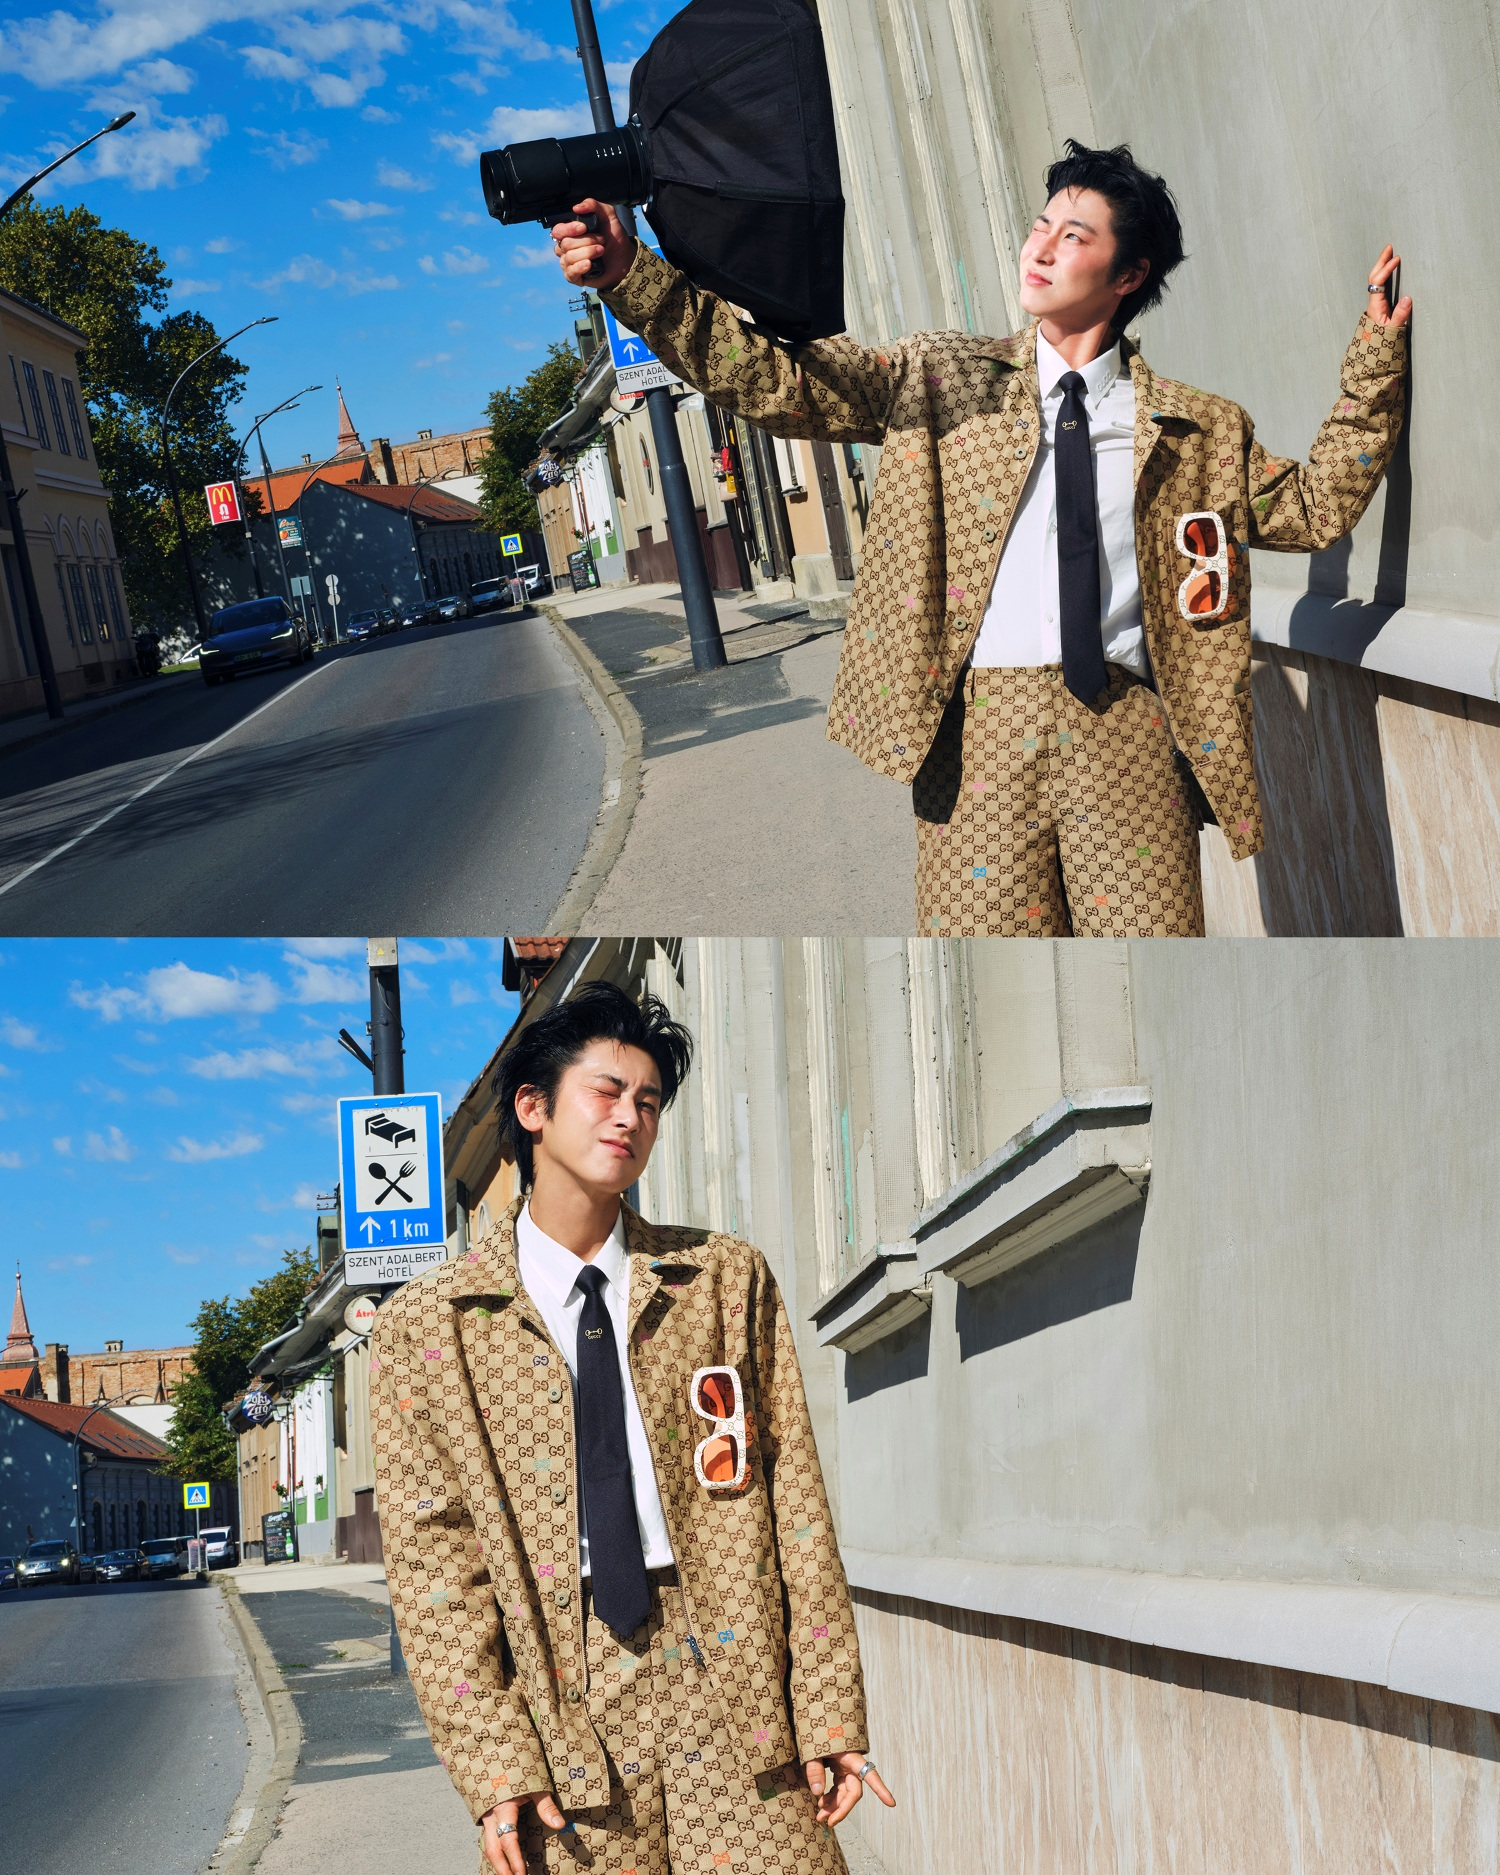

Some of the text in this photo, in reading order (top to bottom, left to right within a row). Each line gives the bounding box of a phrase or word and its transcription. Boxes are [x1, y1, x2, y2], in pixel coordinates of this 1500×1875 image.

[619, 366, 667, 381] SZENT ADAL
[641, 374, 669, 386] HOTEL
[390, 1218, 429, 1239] 1 km
[348, 1251, 443, 1268] SZENT ADALBERT
[378, 1267, 415, 1279] HOTEL
